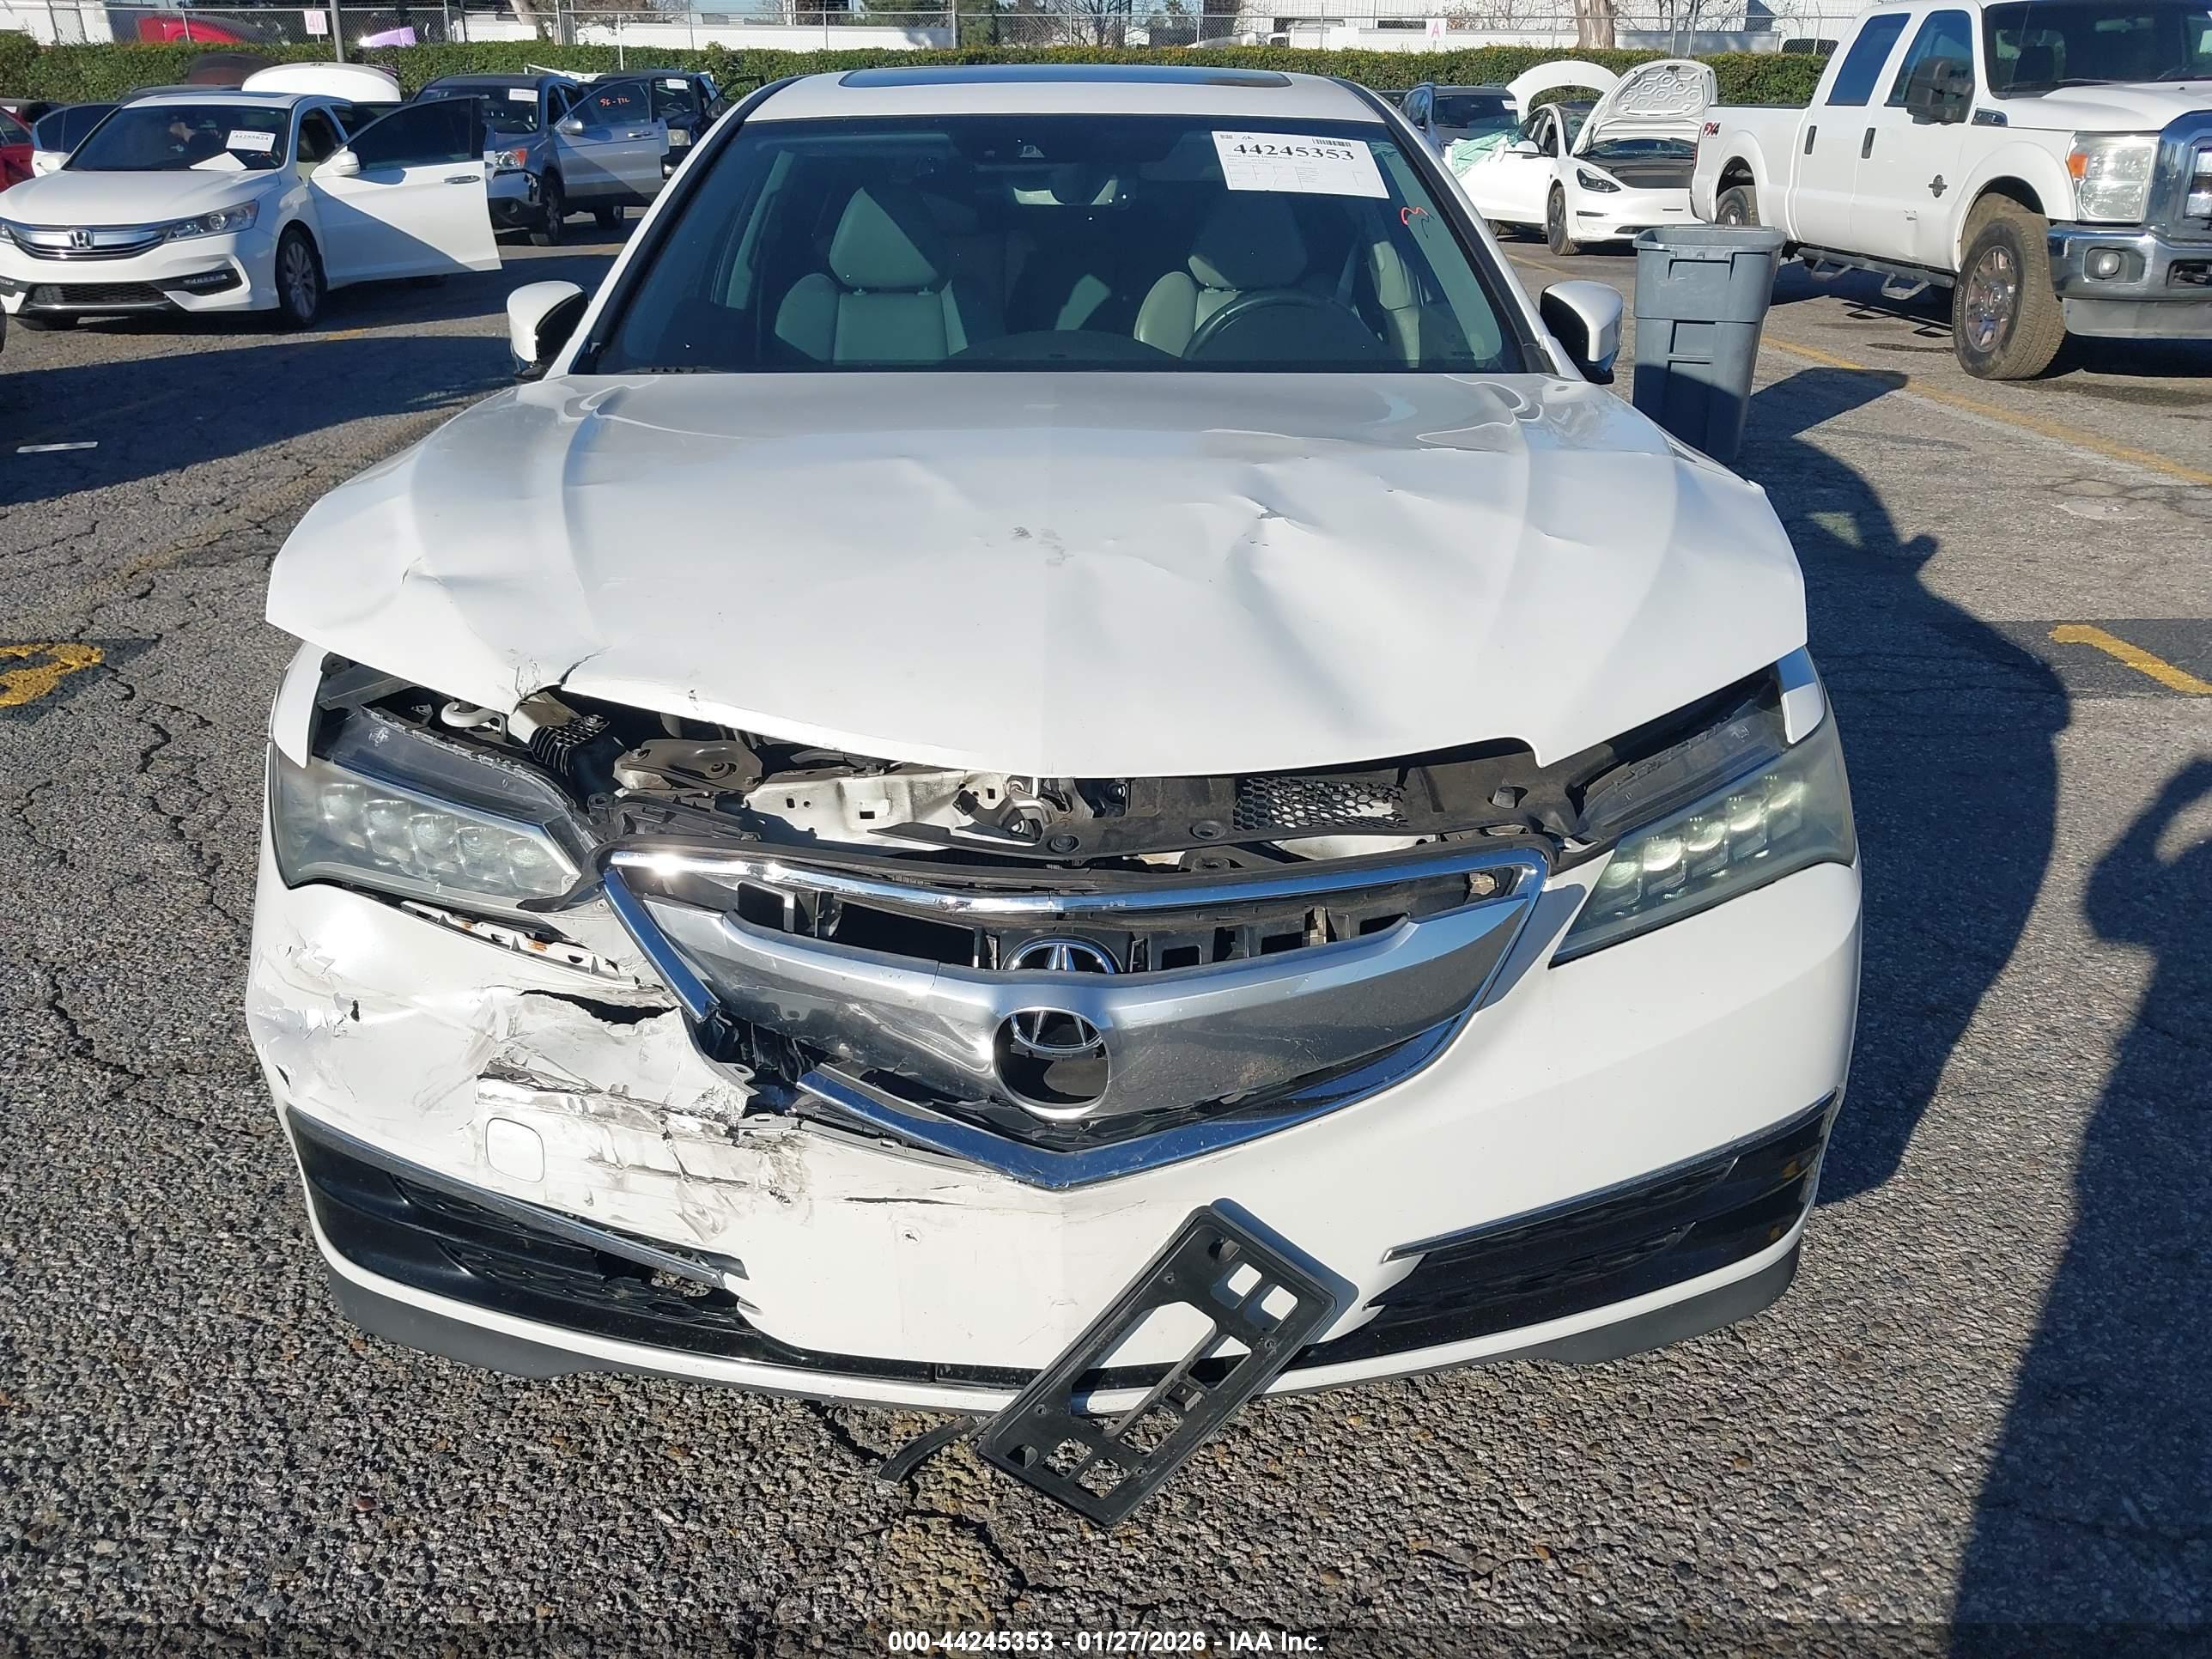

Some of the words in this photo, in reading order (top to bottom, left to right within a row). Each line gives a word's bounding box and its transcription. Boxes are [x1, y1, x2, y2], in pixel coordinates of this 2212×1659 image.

[1431, 20, 1441, 38] A
[1702, 122, 1721, 136] FX4
[1233, 143, 1354, 161] 44245353
